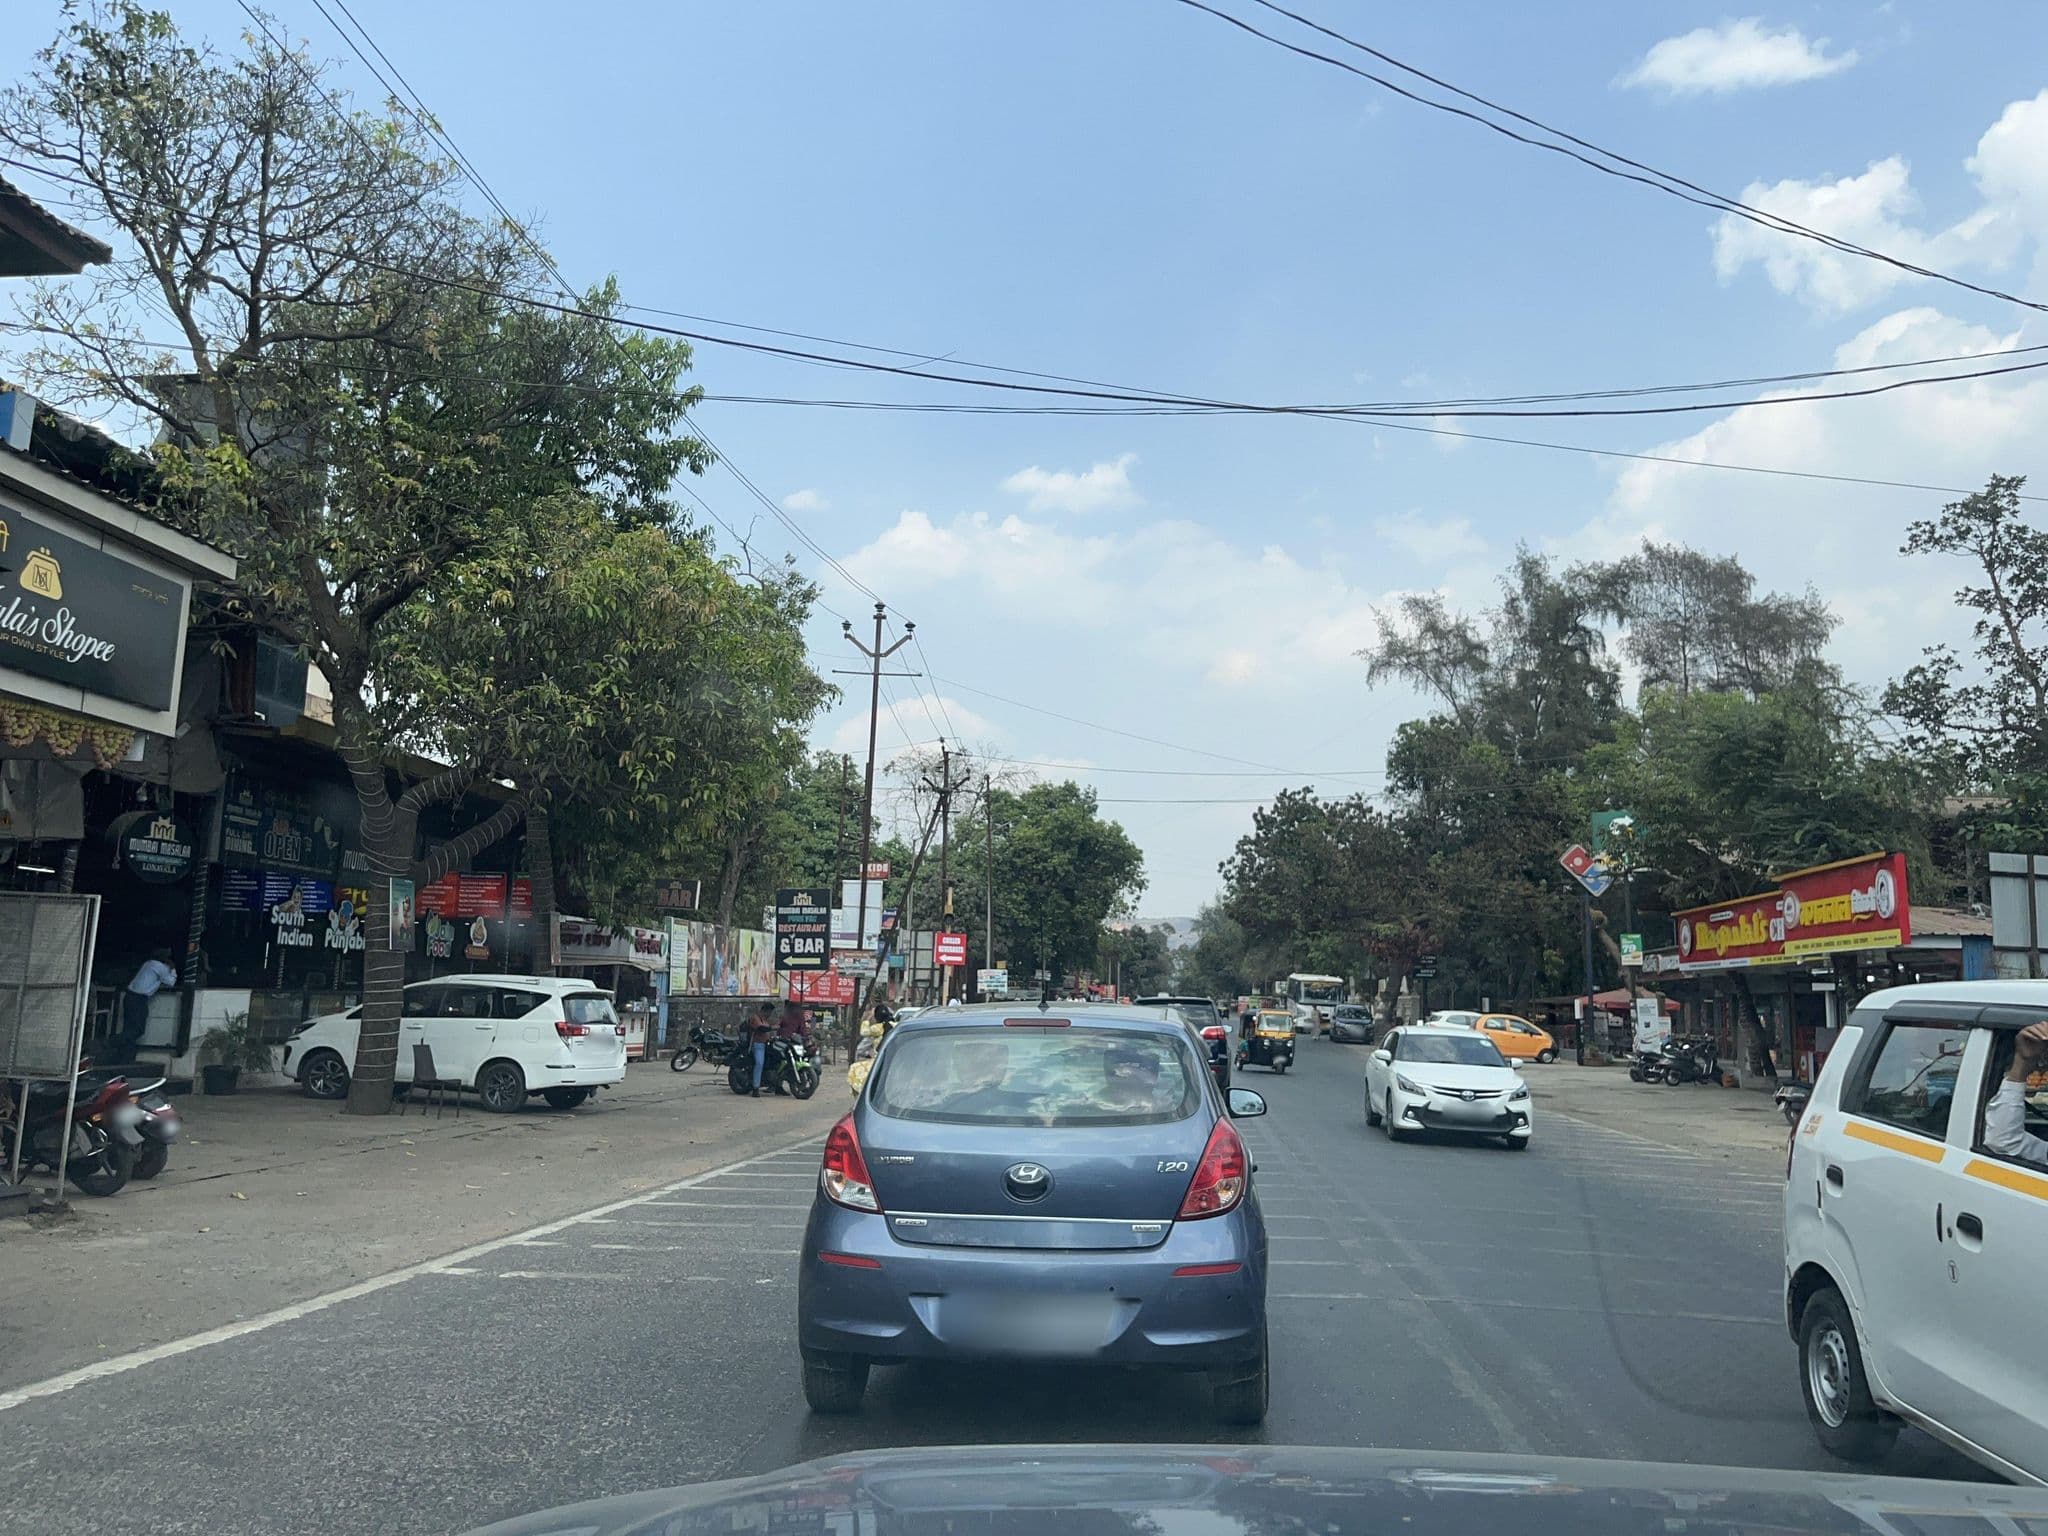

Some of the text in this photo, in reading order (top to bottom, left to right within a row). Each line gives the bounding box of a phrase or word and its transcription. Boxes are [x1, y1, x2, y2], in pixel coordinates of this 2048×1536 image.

[42, 607, 116, 663] Shopee
[11, 635, 35, 650] OWN
[36, 643, 65, 660] STYLE
[129, 838, 159, 854] MUMBAI
[657, 888, 693, 908] BAR
[271, 904, 305, 927] South
[277, 925, 313, 947] Indian
[778, 924, 827, 933] RESTAURANT
[780, 937, 825, 954] & BAR
[1155, 1160, 1188, 1174] i20
